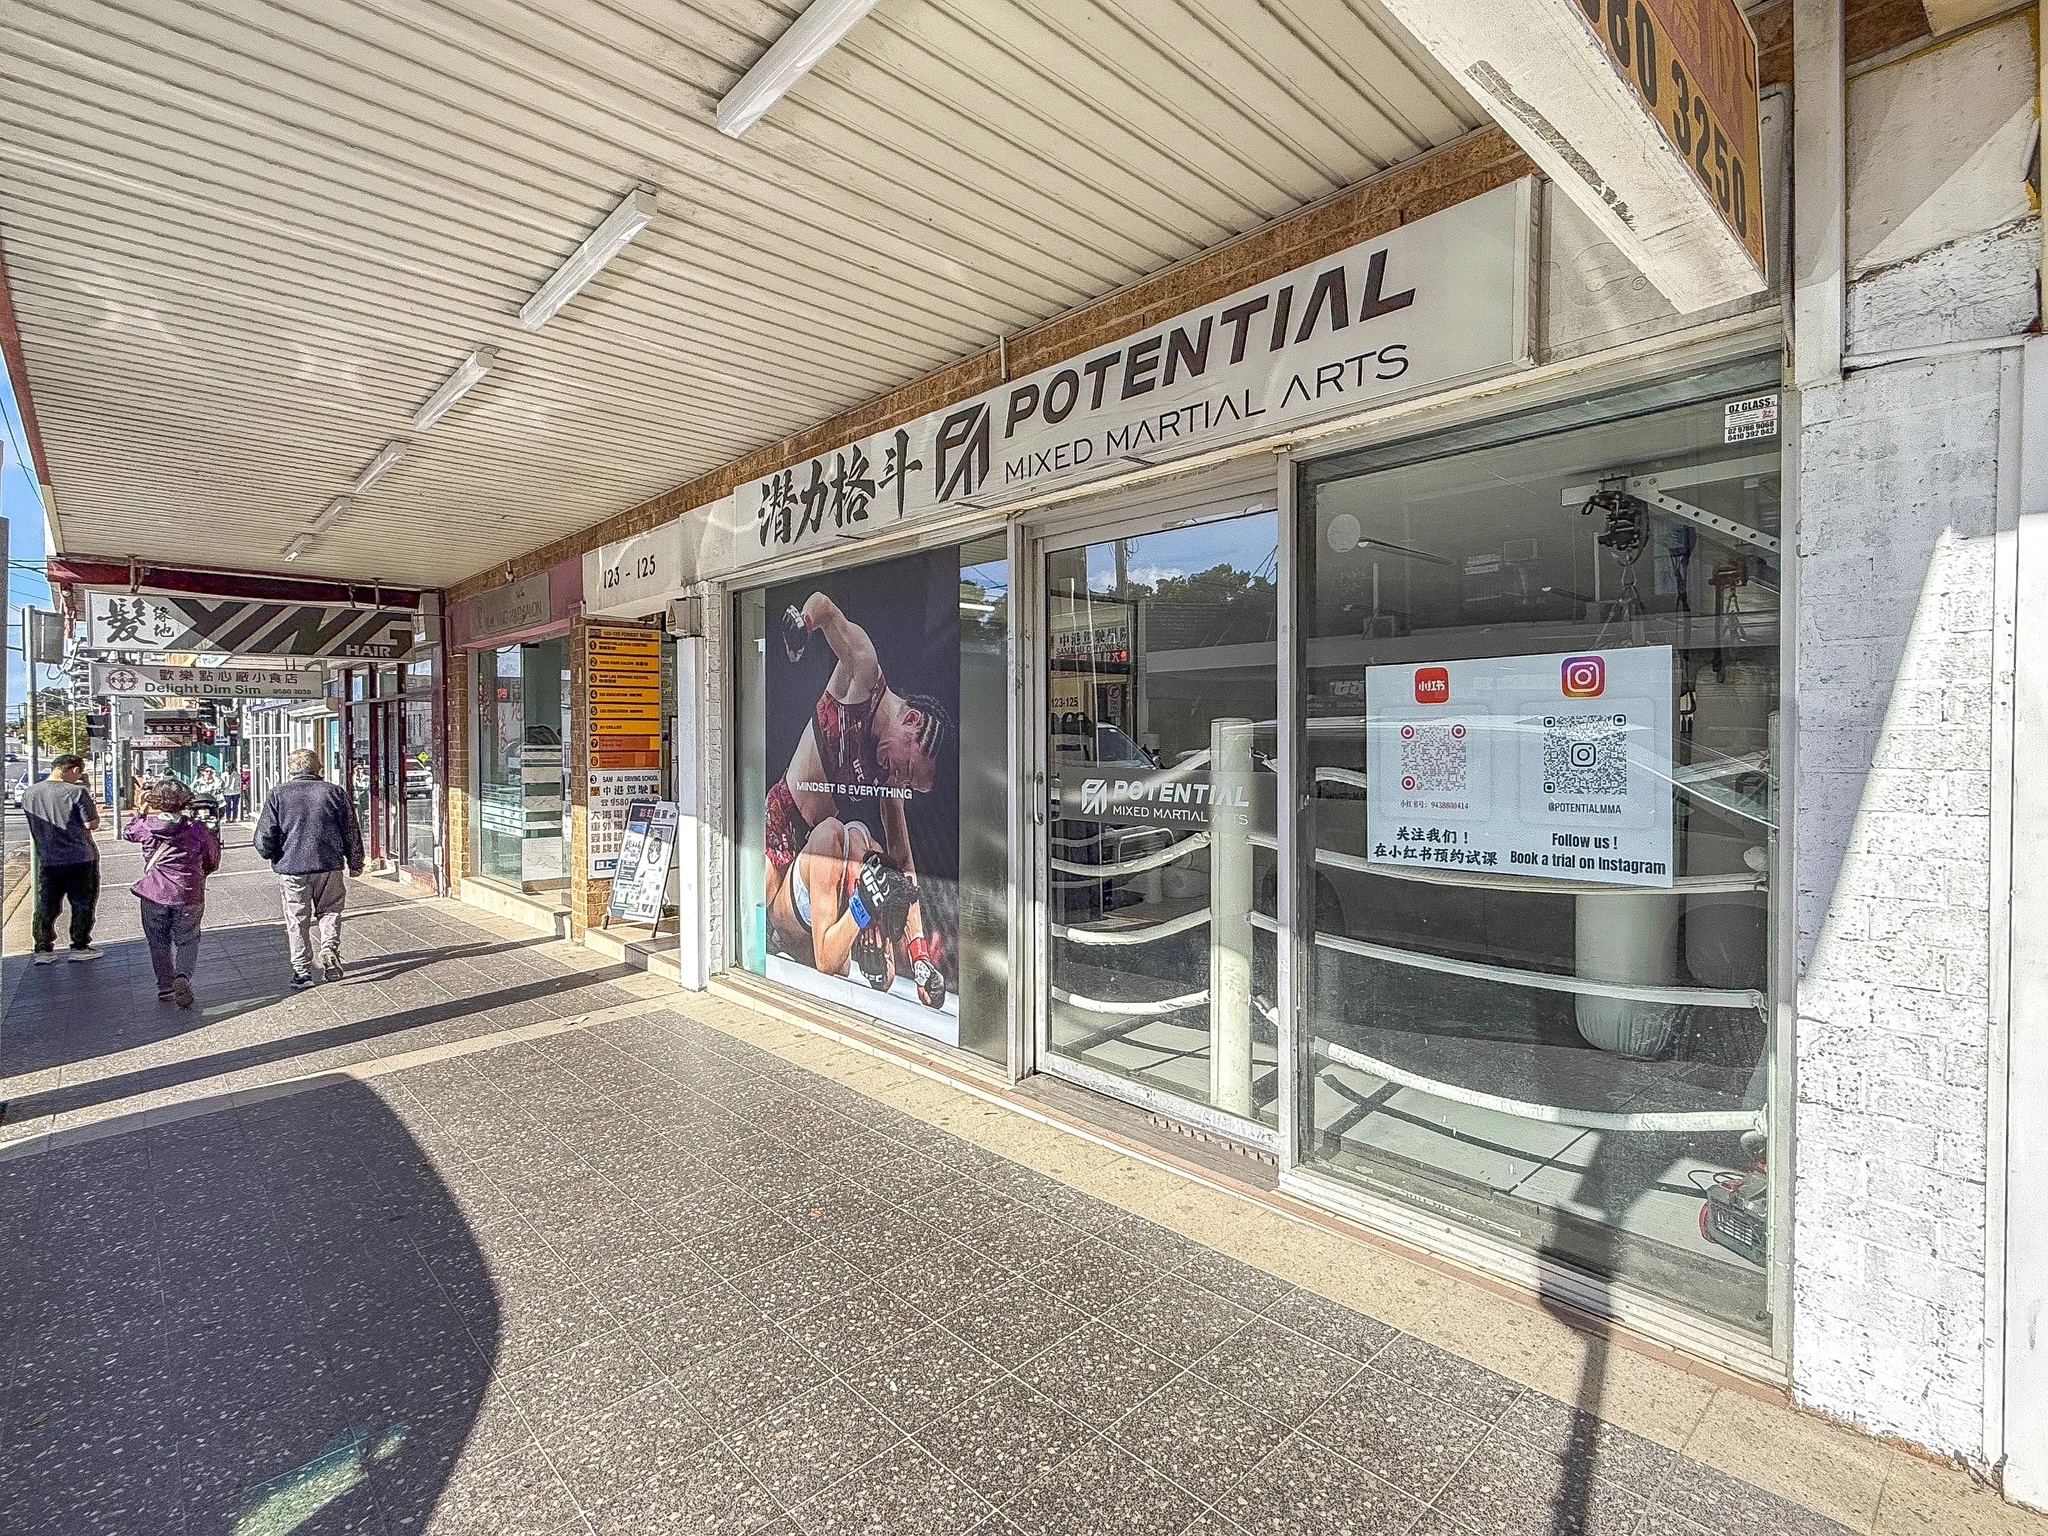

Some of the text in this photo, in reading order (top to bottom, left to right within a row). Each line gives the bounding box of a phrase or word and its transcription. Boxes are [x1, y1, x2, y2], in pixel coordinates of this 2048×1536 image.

[1581, 0, 1658, 108] 80
[1671, 59, 1747, 239] 3250
[1004, 249, 1417, 439] POTENTIAL
[1005, 344, 1410, 484] MIXED MARTIAL ARTS
[1728, 397, 1771, 414] OZ GLASS
[757, 427, 923, 547] 潜力格斗
[603, 566, 620, 589] 123
[637, 554, 656, 579] 125
[97, 598, 158, 645] 髮
[163, 597, 413, 659] YING
[346, 644, 391, 657] HAIR
[144, 682, 200, 695] Delight
[203, 684, 231, 694] Dim
[235, 684, 261, 694] Sim
[1418, 680, 1445, 692] 小红书
[610, 797, 629, 806] 9580
[796, 781, 913, 799] MINDSET IS EVERYTHING
[1113, 780, 1250, 807] POTENTIAL
[1113, 805, 1149, 817] MIXED
[1153, 808, 1209, 822] MARTIAL
[1548, 802, 1622, 814] @POTENTIALMMA
[1552, 832, 1590, 848] Follow
[1594, 837, 1610, 849] us
[1373, 842, 1498, 867] 在小红书预约试课
[1510, 850, 1666, 875] Book a trial on Instagram
[862, 869, 885, 908] UFC
